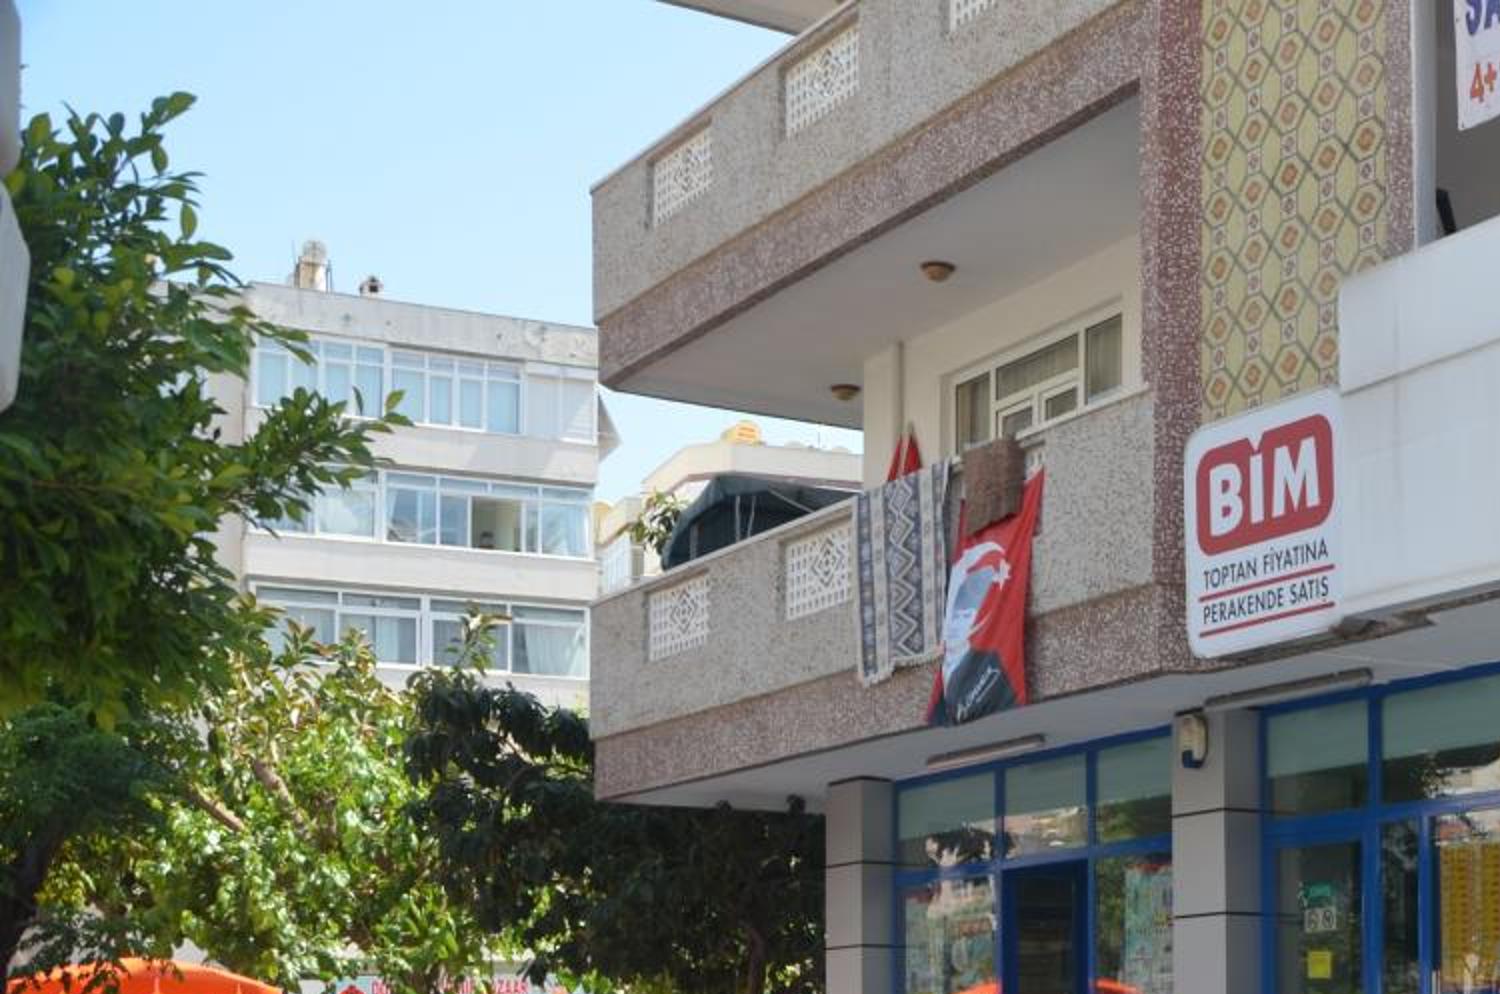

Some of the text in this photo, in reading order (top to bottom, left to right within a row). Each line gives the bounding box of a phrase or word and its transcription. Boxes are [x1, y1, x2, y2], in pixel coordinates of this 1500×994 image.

[1203, 538, 1329, 590] TOPTAN FİYATINA
[1203, 575, 1329, 625] PERAKENDE SATIŞ
